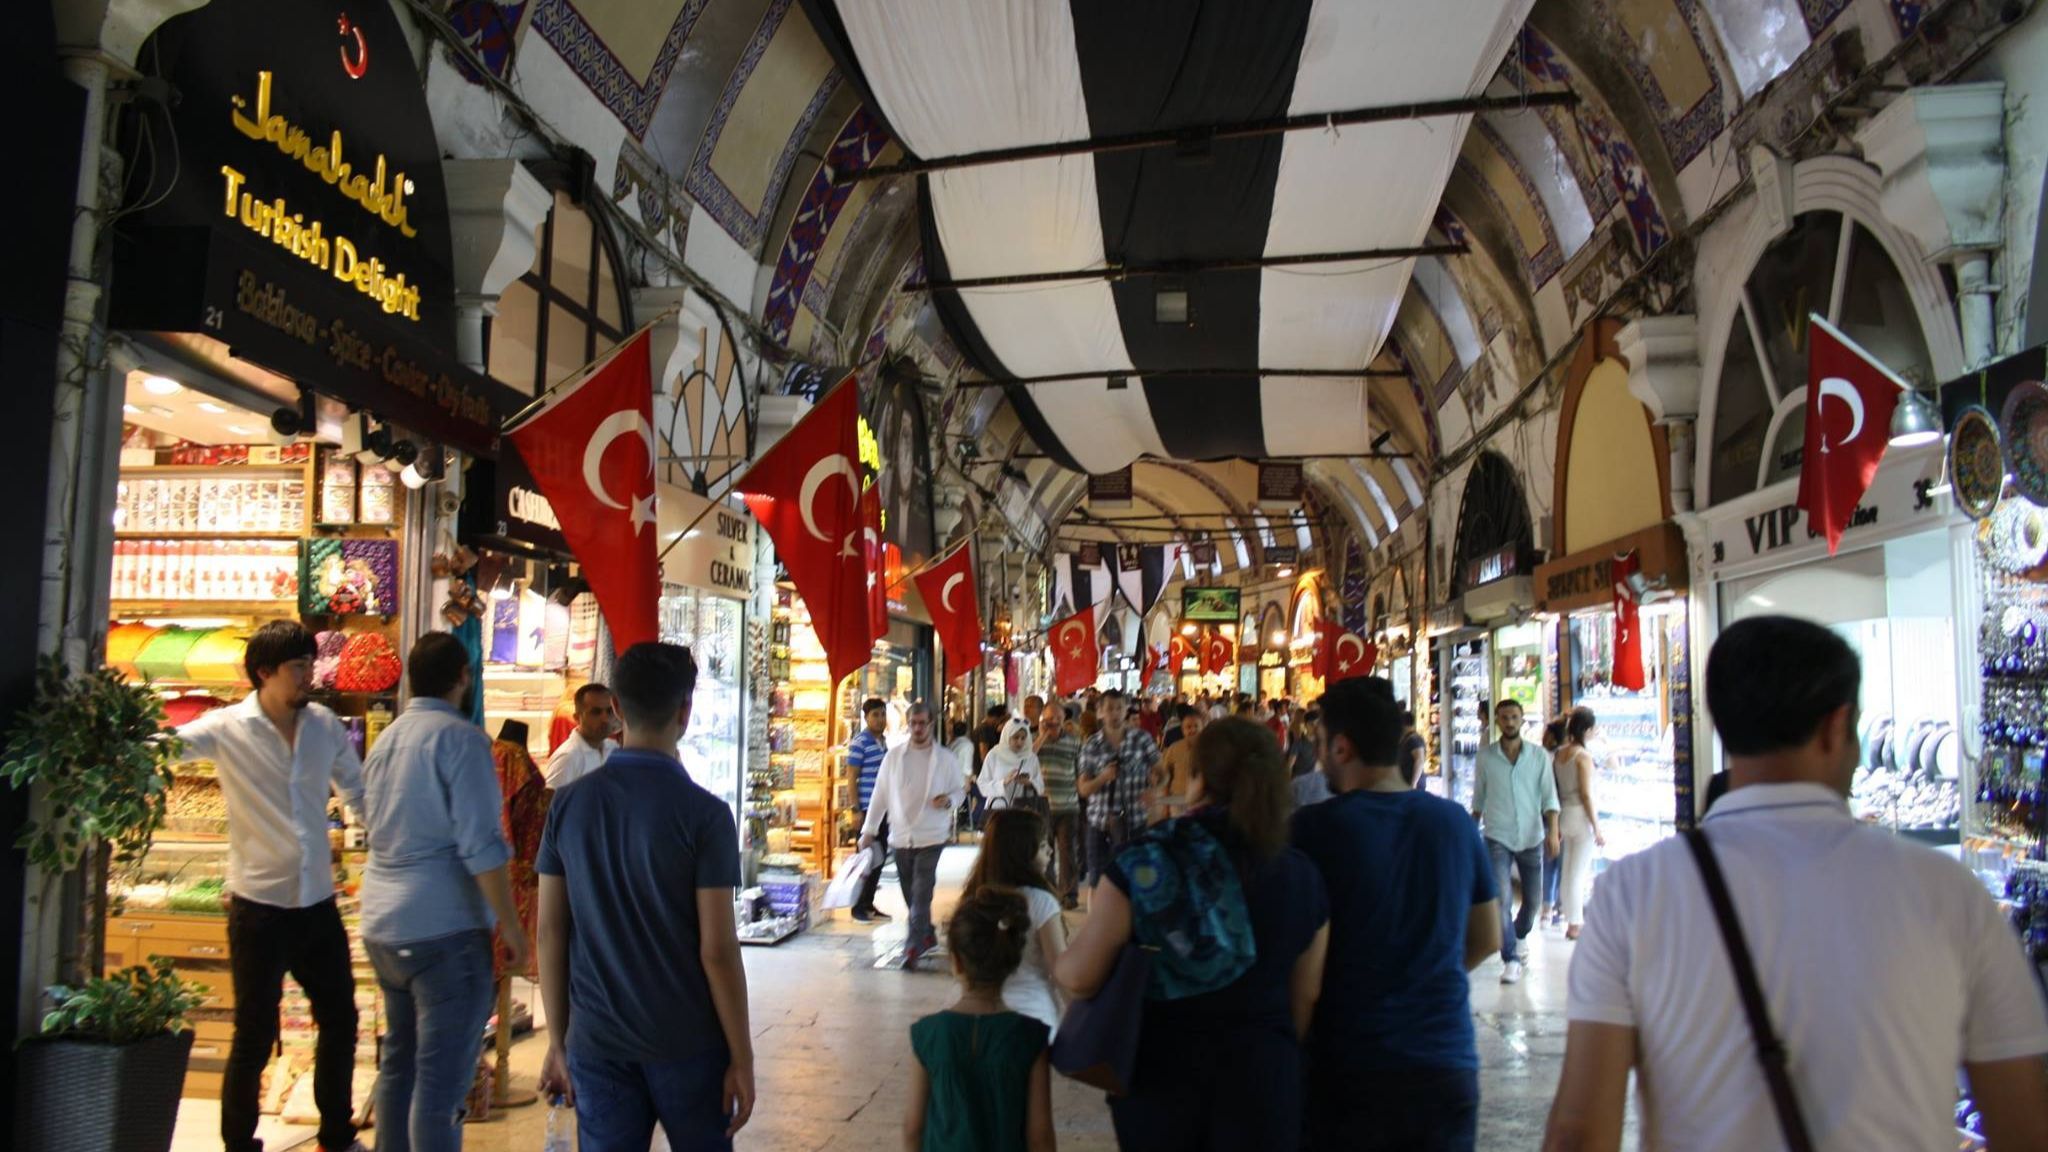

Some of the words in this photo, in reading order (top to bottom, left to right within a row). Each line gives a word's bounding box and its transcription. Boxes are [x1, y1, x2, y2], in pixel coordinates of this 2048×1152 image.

[221, 164, 330, 271] Turkish
[333, 235, 421, 322] Delight
[204, 305, 225, 330] 21
[716, 510, 748, 544] SILVER
[1745, 504, 1799, 555] VIP
[710, 559, 753, 593] CERAMIC
